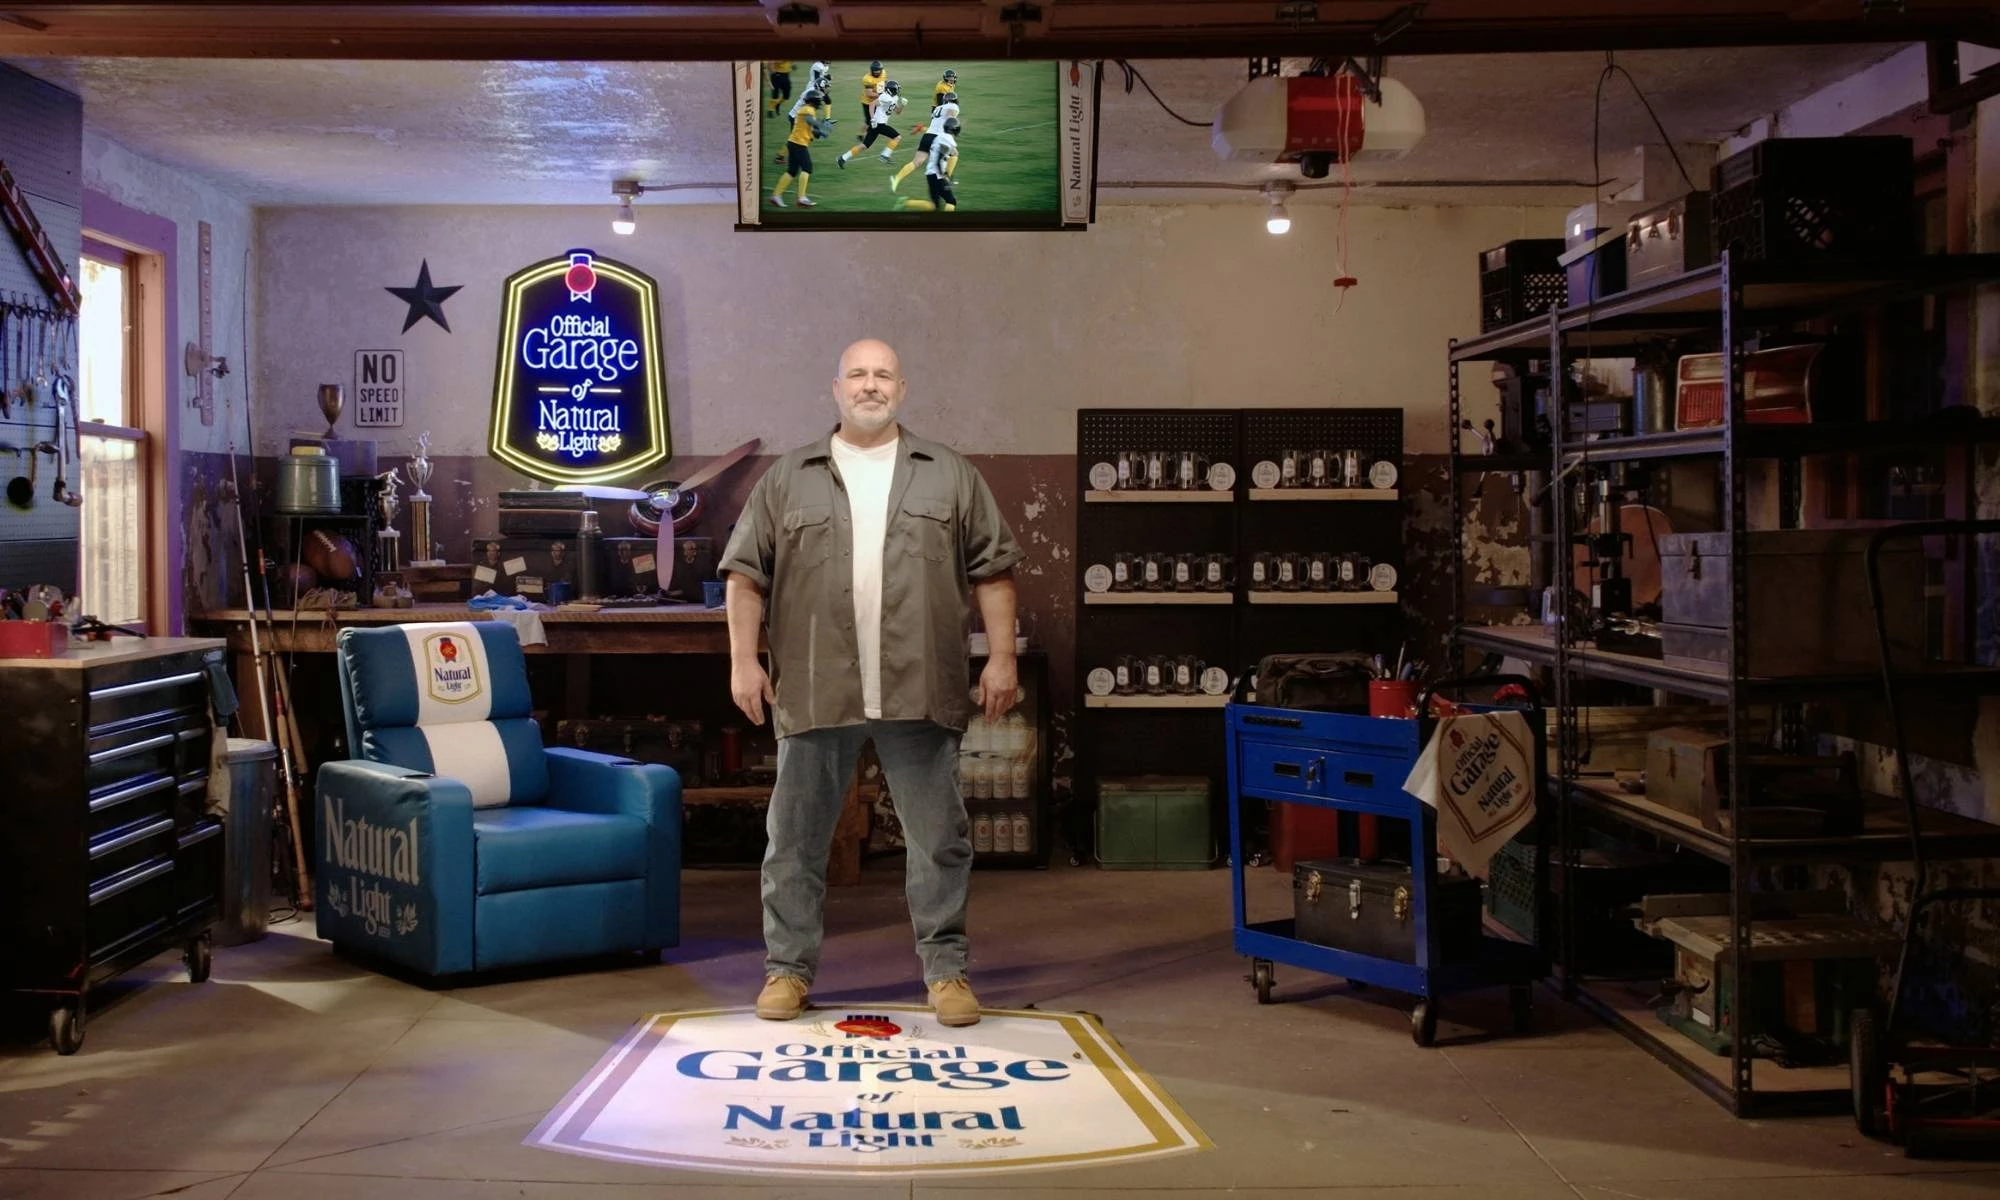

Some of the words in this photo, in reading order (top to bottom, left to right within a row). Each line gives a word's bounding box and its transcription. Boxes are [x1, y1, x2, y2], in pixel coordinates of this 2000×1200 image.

[1069, 95, 1084, 133] Light
[743, 139, 753, 192] Natural
[1070, 136, 1081, 190] Natural
[551, 315, 610, 337] Official
[363, 354, 396, 384] NO
[522, 328, 639, 381] Garage
[360, 388, 398, 403] SPEED
[571, 378, 593, 401] of
[360, 407, 398, 422] LIMIT
[538, 400, 621, 432] Natural
[558, 431, 600, 458] Light
[434, 667, 471, 681] Natural
[1450, 733, 1501, 796] Garage
[1456, 736, 1484, 771] Official
[1478, 765, 1517, 813] Natural
[324, 794, 420, 886] Natural
[351, 876, 392, 936] Light
[774, 1043, 969, 1060] Official
[676, 1050, 1071, 1090] Garage
[857, 1090, 903, 1104] of
[723, 1104, 1026, 1131] Natural
[808, 1131, 946, 1153] Light
